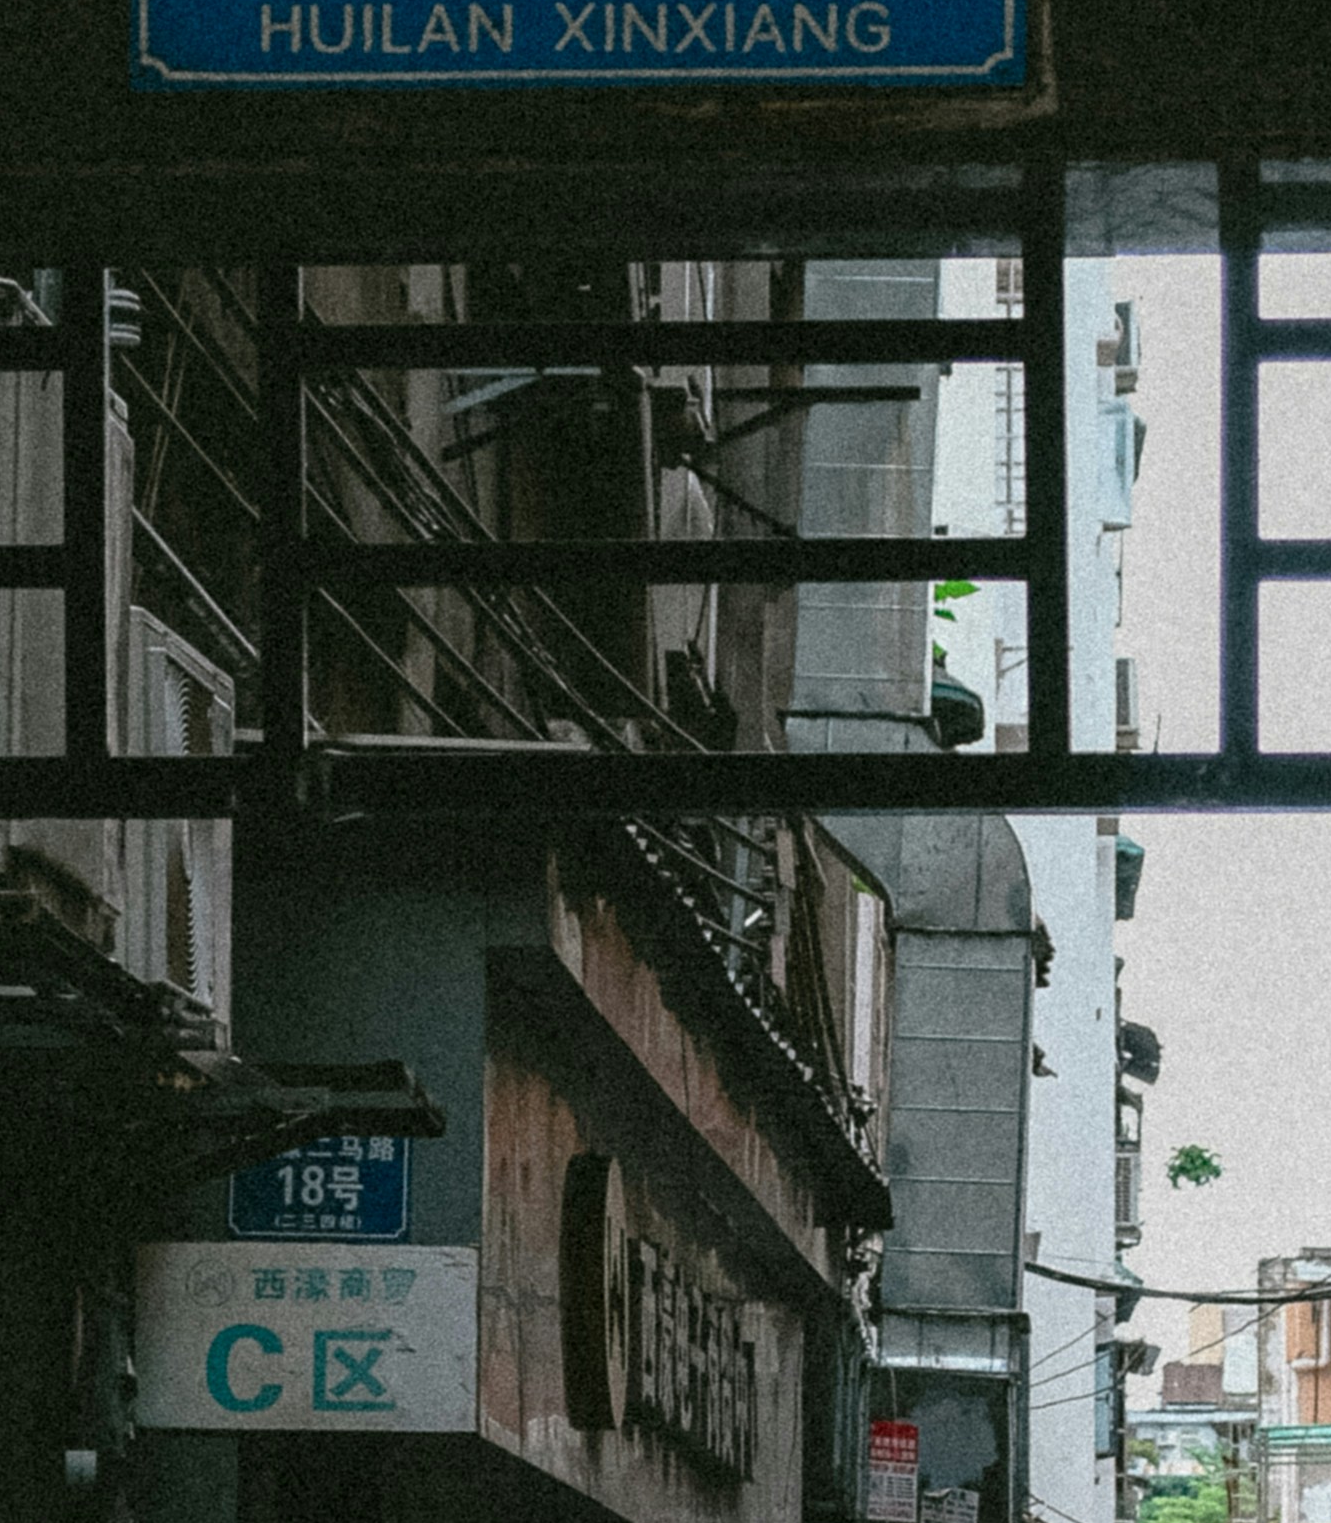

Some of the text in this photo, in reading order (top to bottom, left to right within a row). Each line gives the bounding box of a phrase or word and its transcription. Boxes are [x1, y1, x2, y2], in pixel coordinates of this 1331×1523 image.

[258, 0, 894, 55] HUILAN XINXIANG
[275, 1164, 365, 1212] 18号
[206, 1323, 397, 1413] C区
